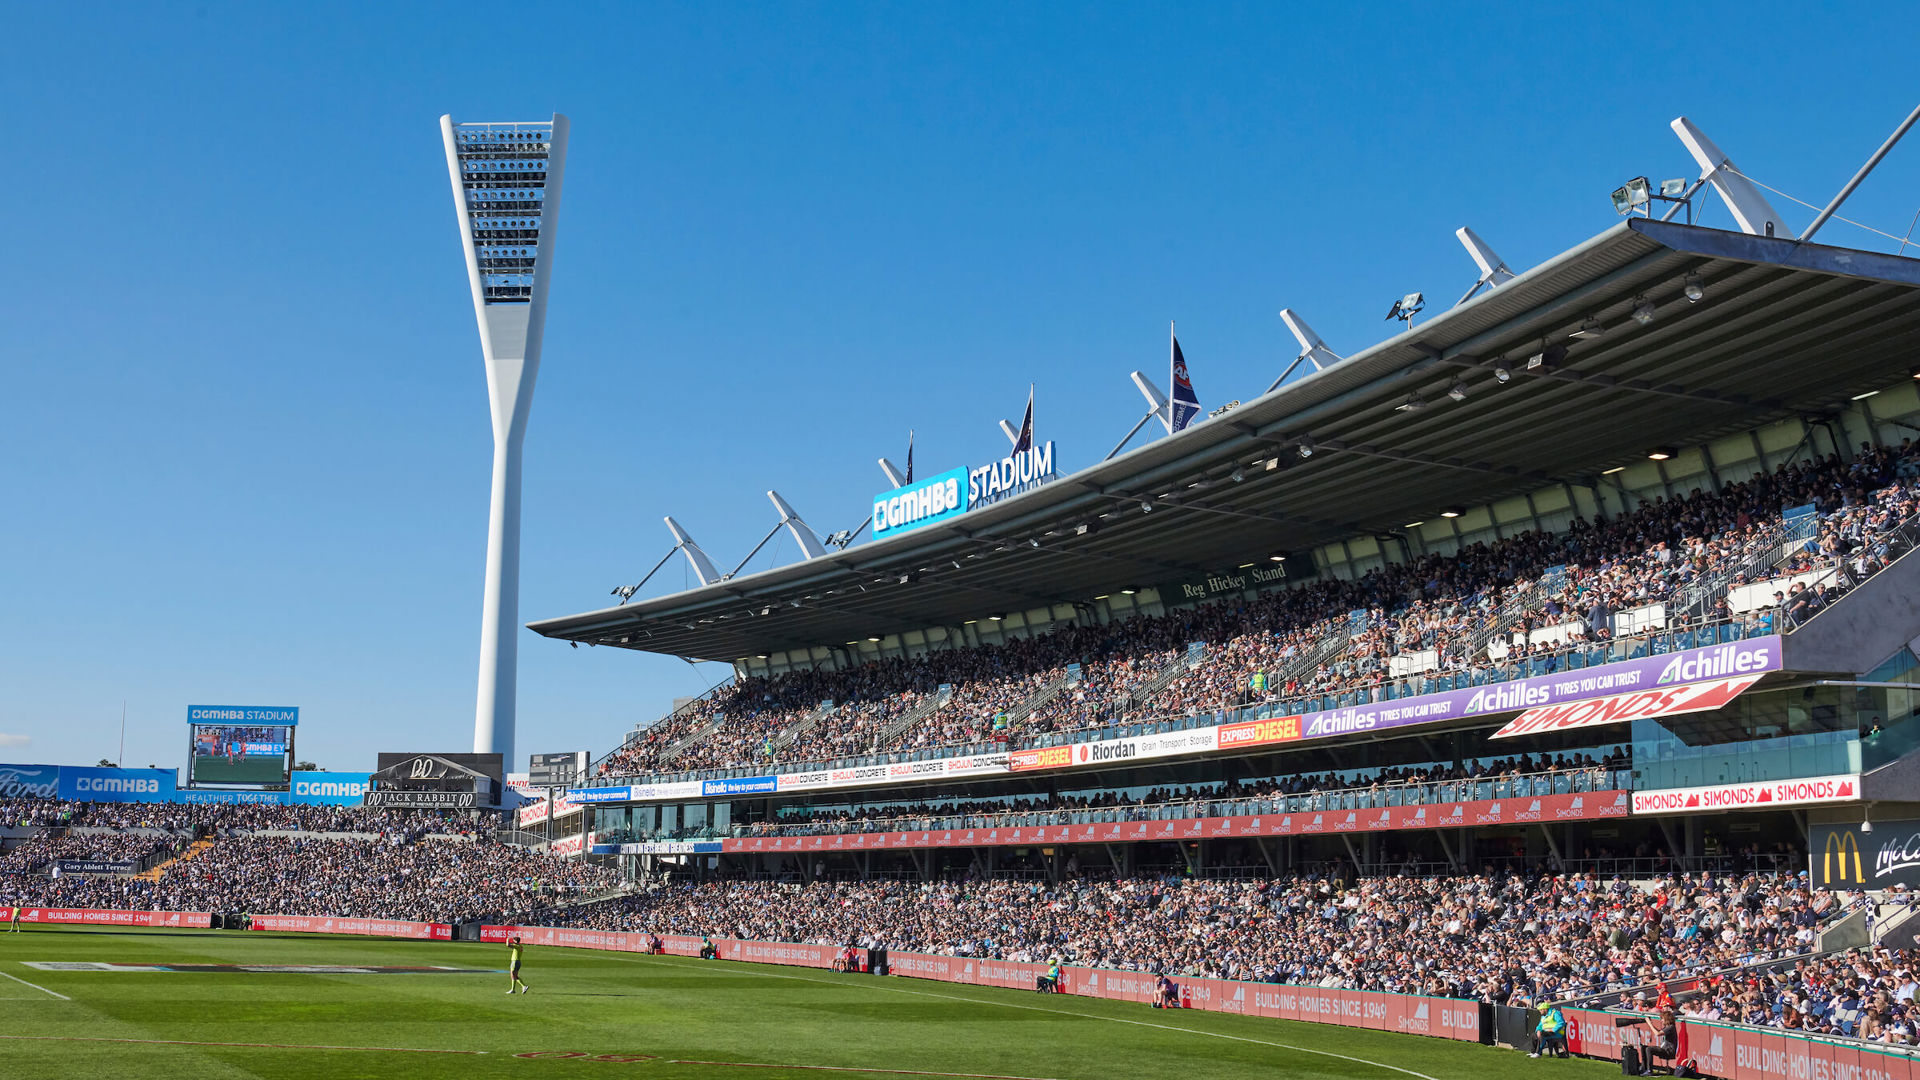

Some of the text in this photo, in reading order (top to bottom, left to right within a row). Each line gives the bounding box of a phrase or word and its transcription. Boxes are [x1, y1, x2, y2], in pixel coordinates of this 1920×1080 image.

[969, 441, 1053, 501] STADIUM
[1182, 564, 1286, 598] Reg Hickey Stand
[1657, 645, 1769, 684] Achilles
[1464, 670, 1641, 714] Achilles TYRES YOU CAN TRUST
[246, 711, 294, 720] STADIUM
[1306, 702, 1452, 736] Achilles TYRES YOU CAN TRUST
[1497, 687, 1691, 735] SIMONDS
[1220, 719, 1298, 743] EXPRESS DIESEL
[1092, 740, 1136, 761] Riordan
[1142, 735, 1212, 752] Grain Transport Storage
[1038, 748, 1071, 766] DIESEL
[186, 793, 279, 803] HEALTHIER TOGETHER
[383, 794, 457, 802] JACK RABBIT
[1635, 781, 1833, 811] SIMONDS SIMONDS SIMONDS
[521, 805, 543, 823] SIMONDS
[1477, 813, 1500, 823] SIMONDS
[1515, 811, 1541, 820] SIMONDS
[1556, 808, 1583, 818] SIMONDS
[1599, 805, 1628, 816] SIMONDS
[1334, 822, 1356, 831] SIMONDS
[1368, 820, 1390, 829] SIMONDS
[1402, 817, 1426, 828] SIMONDS
[1439, 815, 1463, 824] SIMONDS
[48, 912, 152, 922] BUILDING HOMES SINCE 1949
[280, 919, 295, 927] SINCE
[488, 930, 507, 938] HOMES
[507, 931, 522, 939] SINCE
[746, 946, 770, 956] BUILDING
[772, 948, 790, 959] HOMES
[791, 949, 807, 960] SINCE
[896, 958, 915, 970] HOMES
[917, 960, 933, 972] SINCE
[934, 962, 948, 974] 1949
[980, 966, 1033, 983] BUILDING HOMES
[1106, 978, 1138, 992] BUILDING
[1192, 986, 1210, 1001] 1949
[1220, 997, 1245, 1011] SIMONDS
[1255, 991, 1386, 1020] BUILDING HOMES SINCE 1949
[1398, 1015, 1429, 1031] SIMONDS
[1442, 1009, 1478, 1030] BUILDI
[1578, 1022, 1616, 1046] HOMES
[1737, 1044, 1788, 1075] BUILDING
[1790, 1053, 1829, 1080] HOMES
[1831, 1061, 1862, 1080] SINCE
